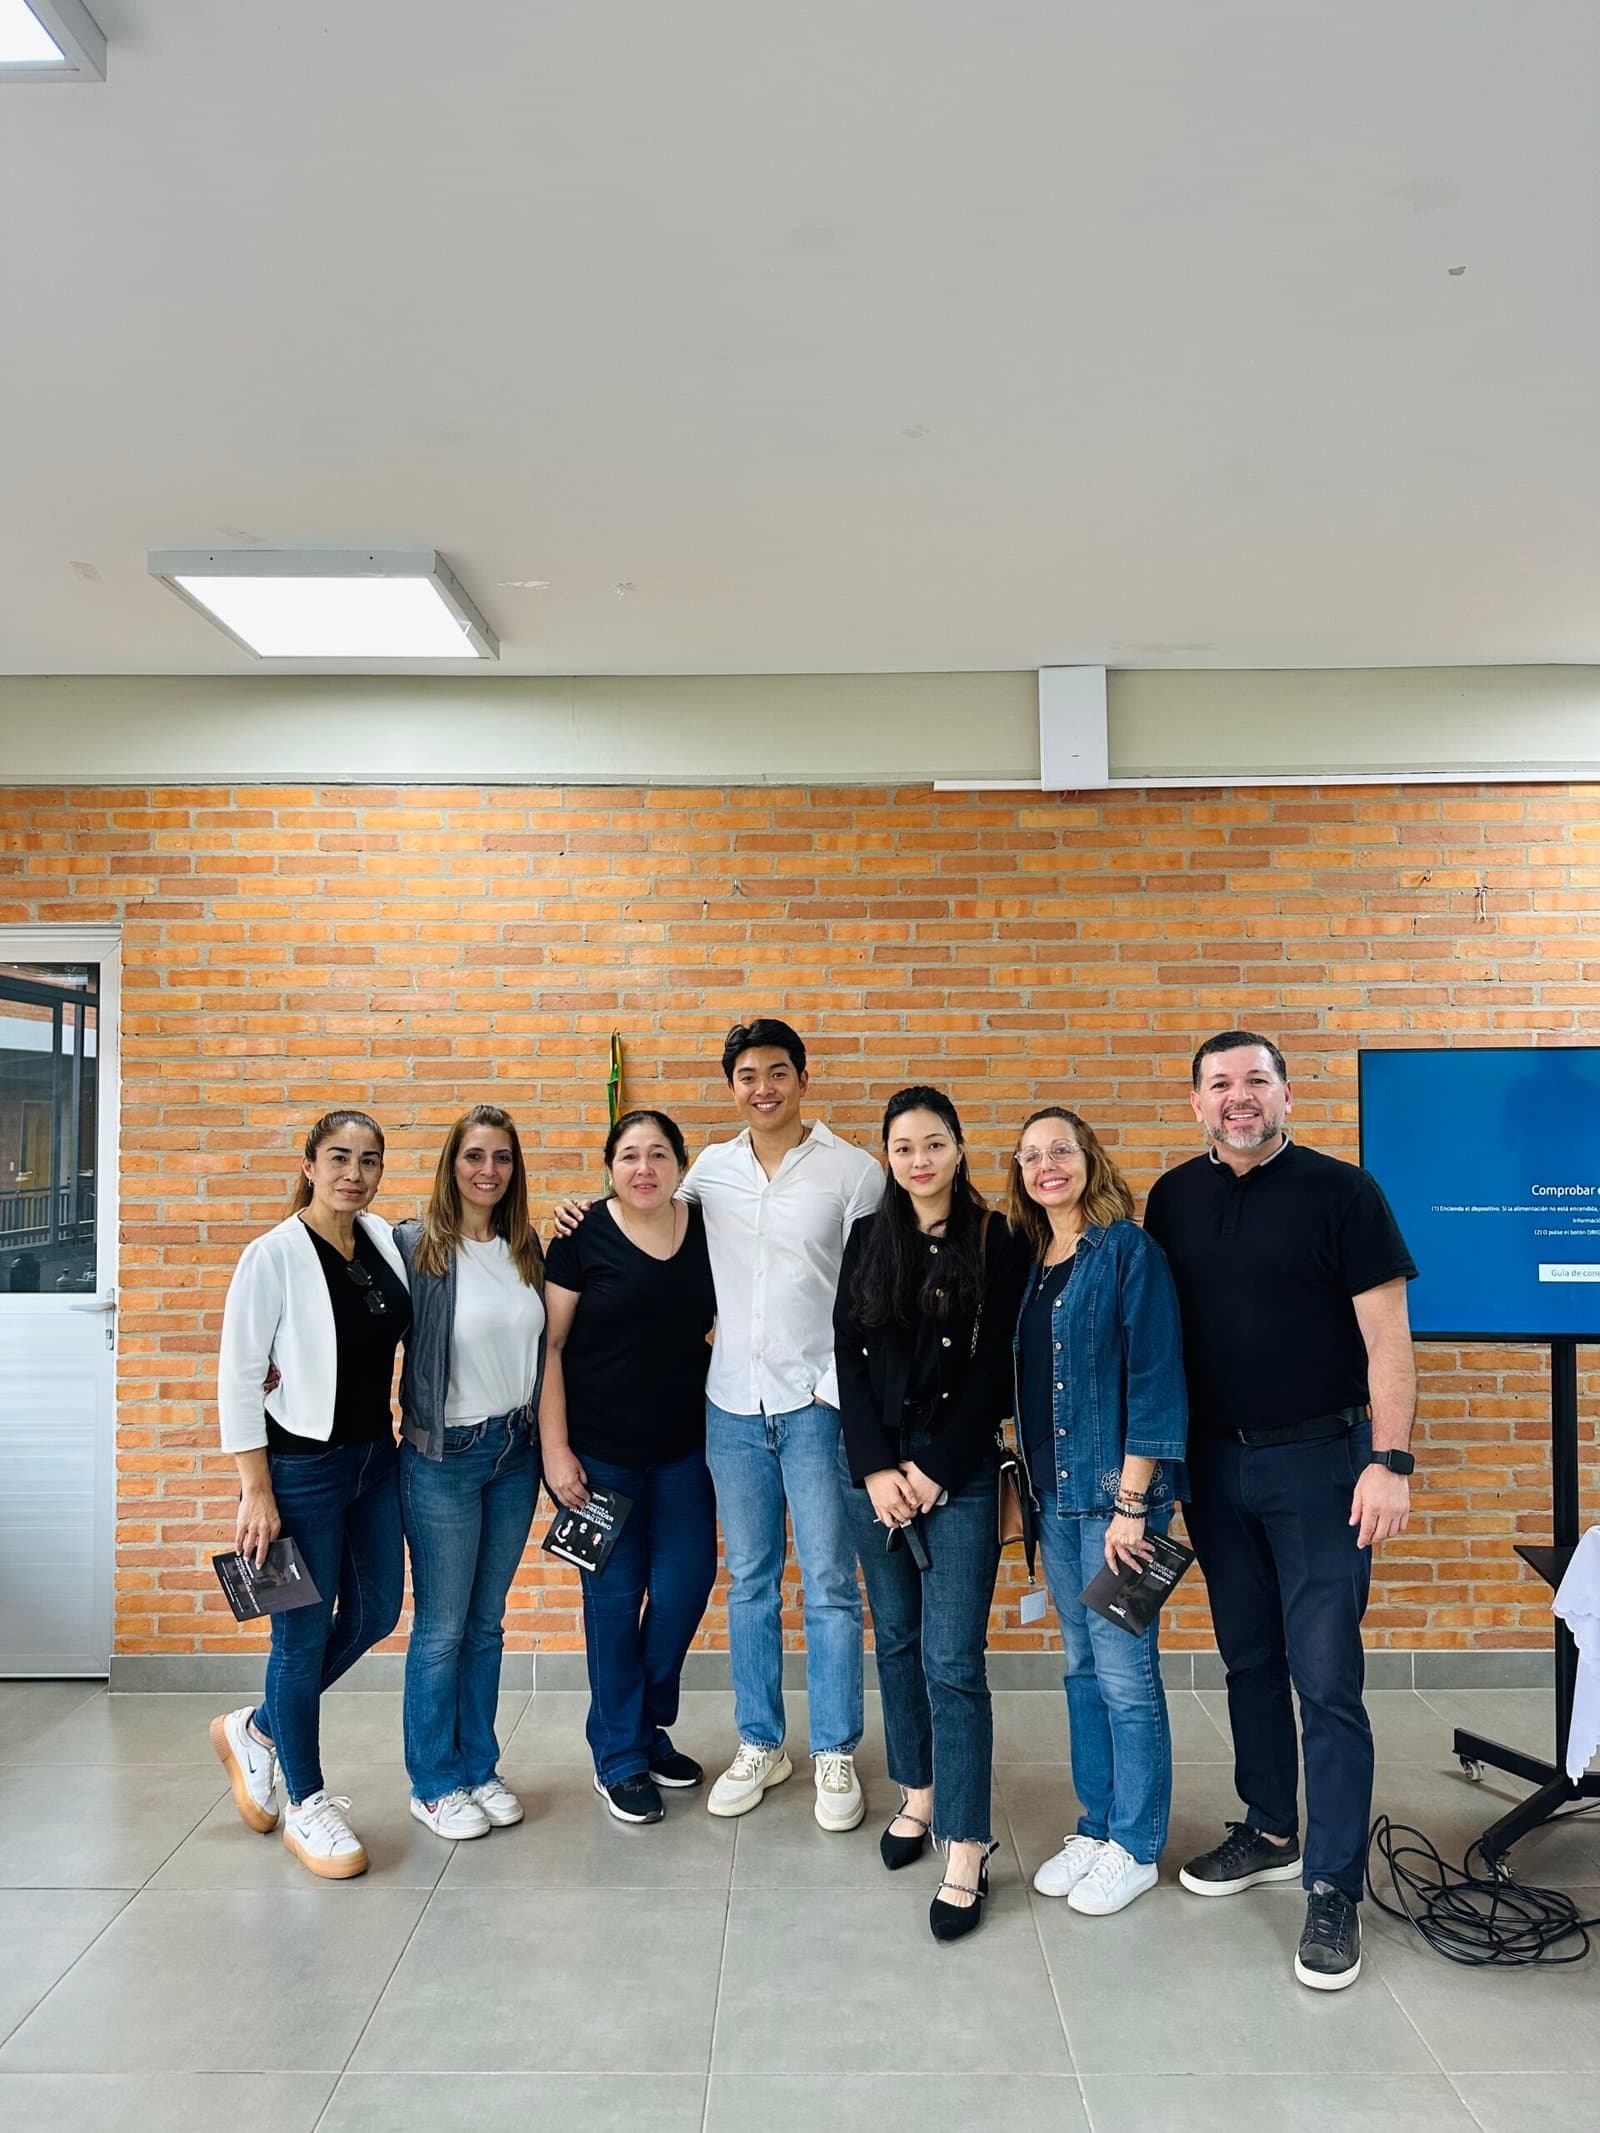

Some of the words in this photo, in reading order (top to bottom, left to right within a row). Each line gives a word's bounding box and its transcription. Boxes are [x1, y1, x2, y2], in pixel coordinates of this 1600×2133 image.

[1532, 1184, 1596, 1198] Comprobar
[1551, 1268, 1570, 1277] Guía
[1571, 1269, 1582, 1277] de
